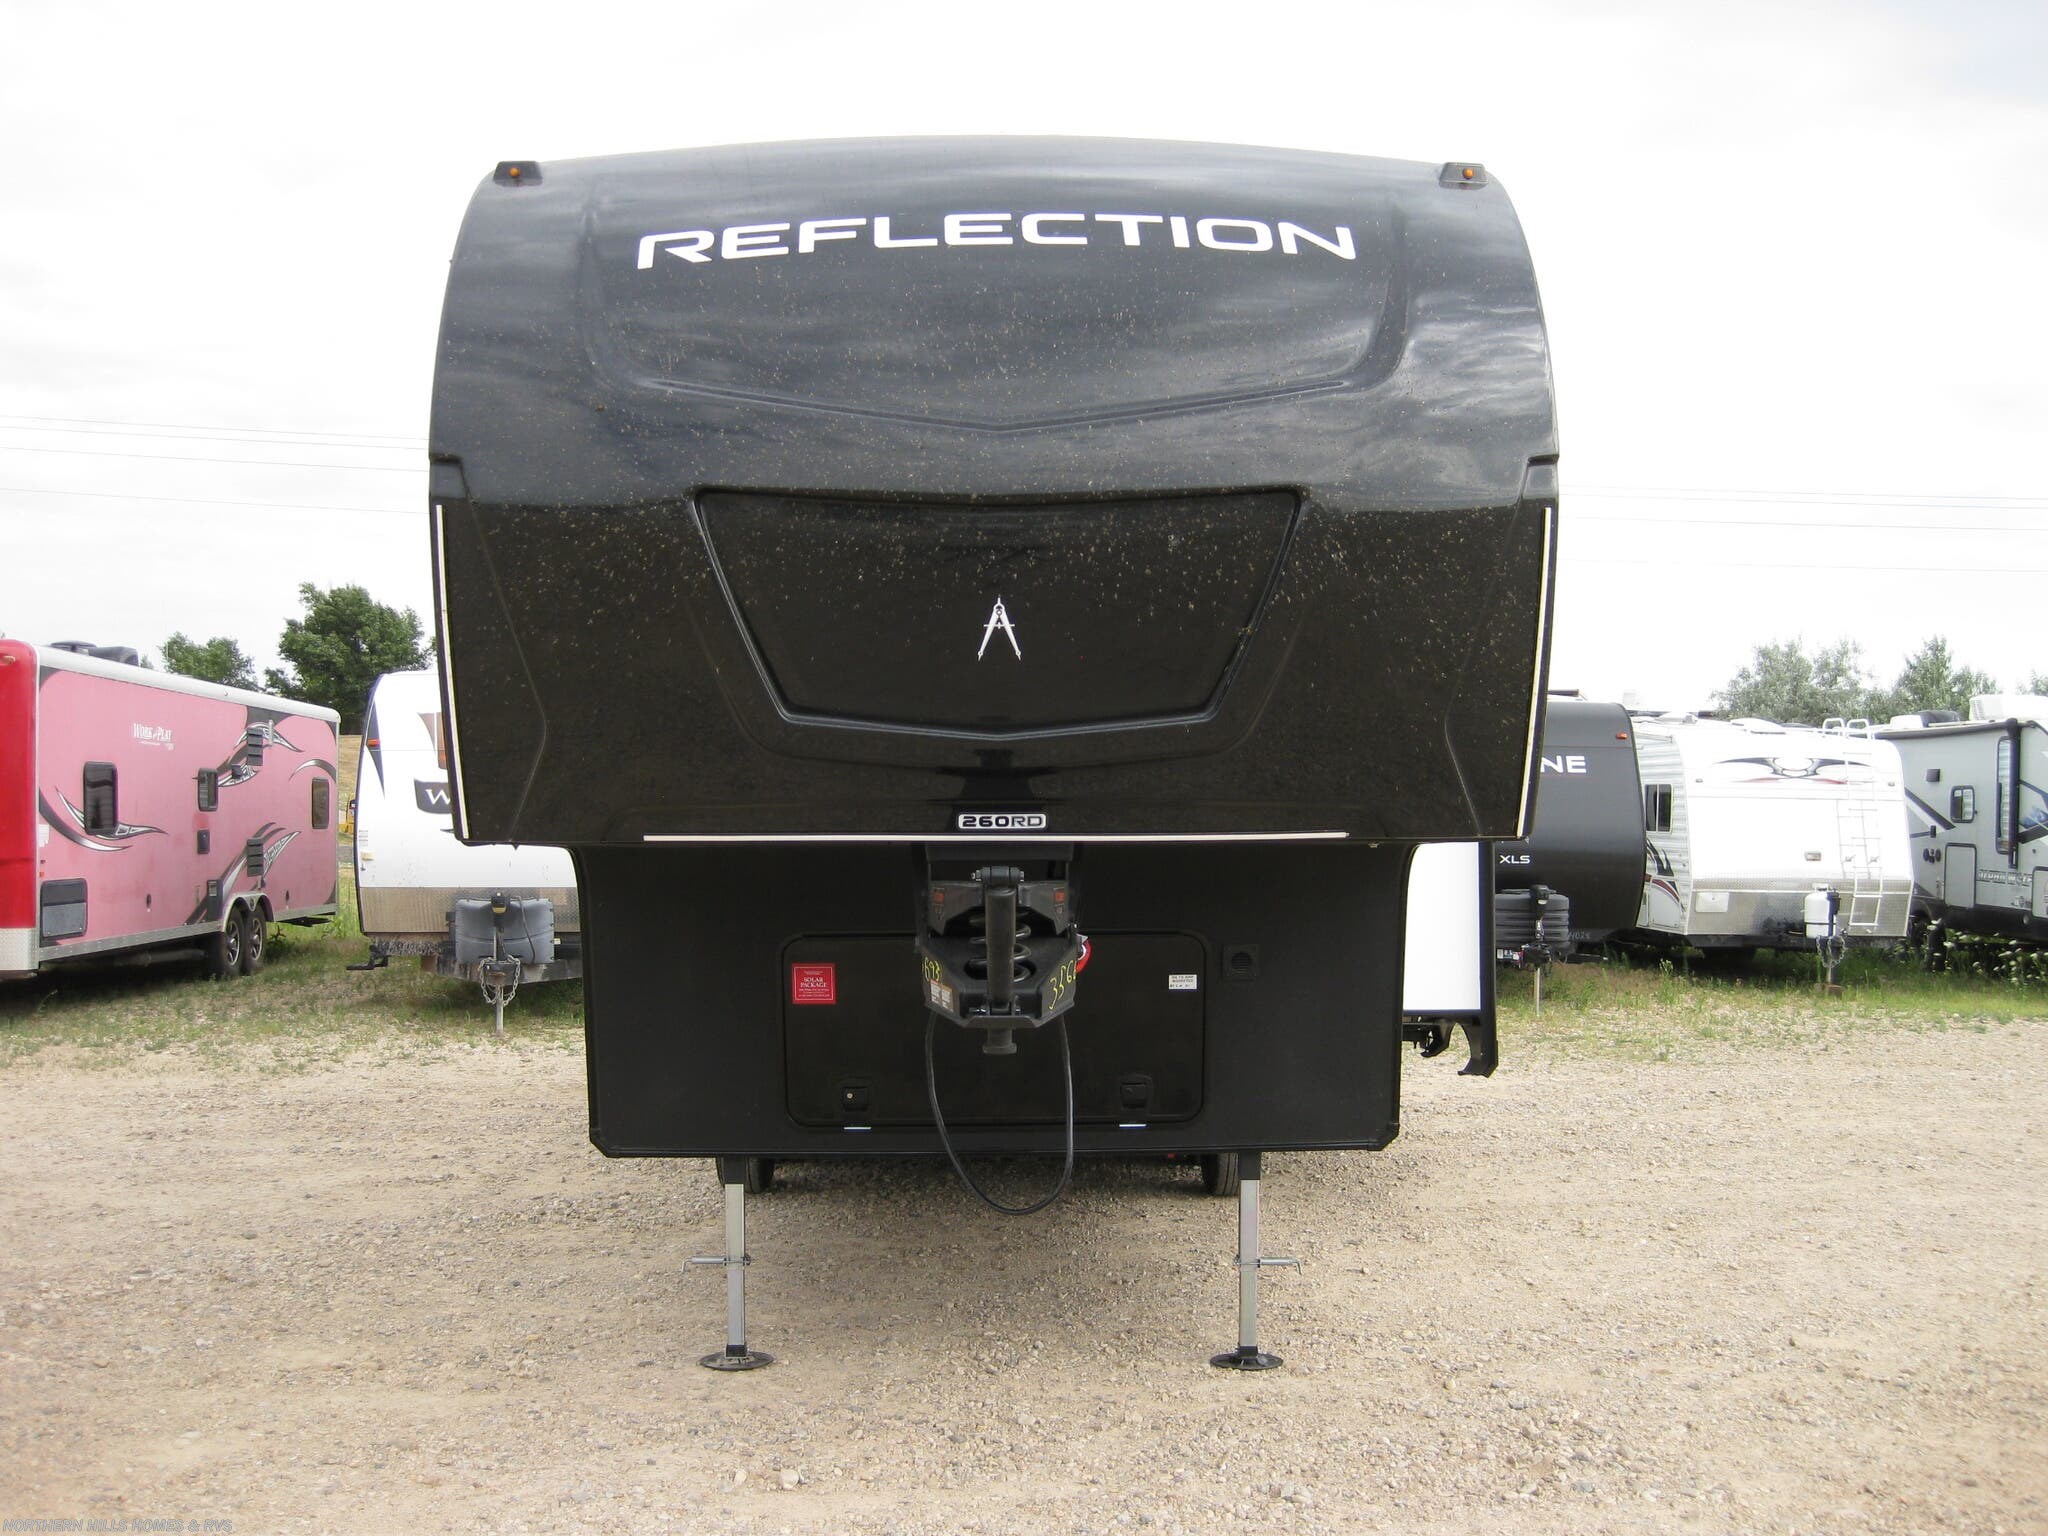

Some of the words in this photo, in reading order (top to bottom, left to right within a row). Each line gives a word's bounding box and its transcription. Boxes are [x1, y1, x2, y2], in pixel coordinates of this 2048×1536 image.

[636, 212, 1358, 270] REFLECTION
[962, 815, 1043, 828] 260RD
[1499, 854, 1531, 864] XLS
